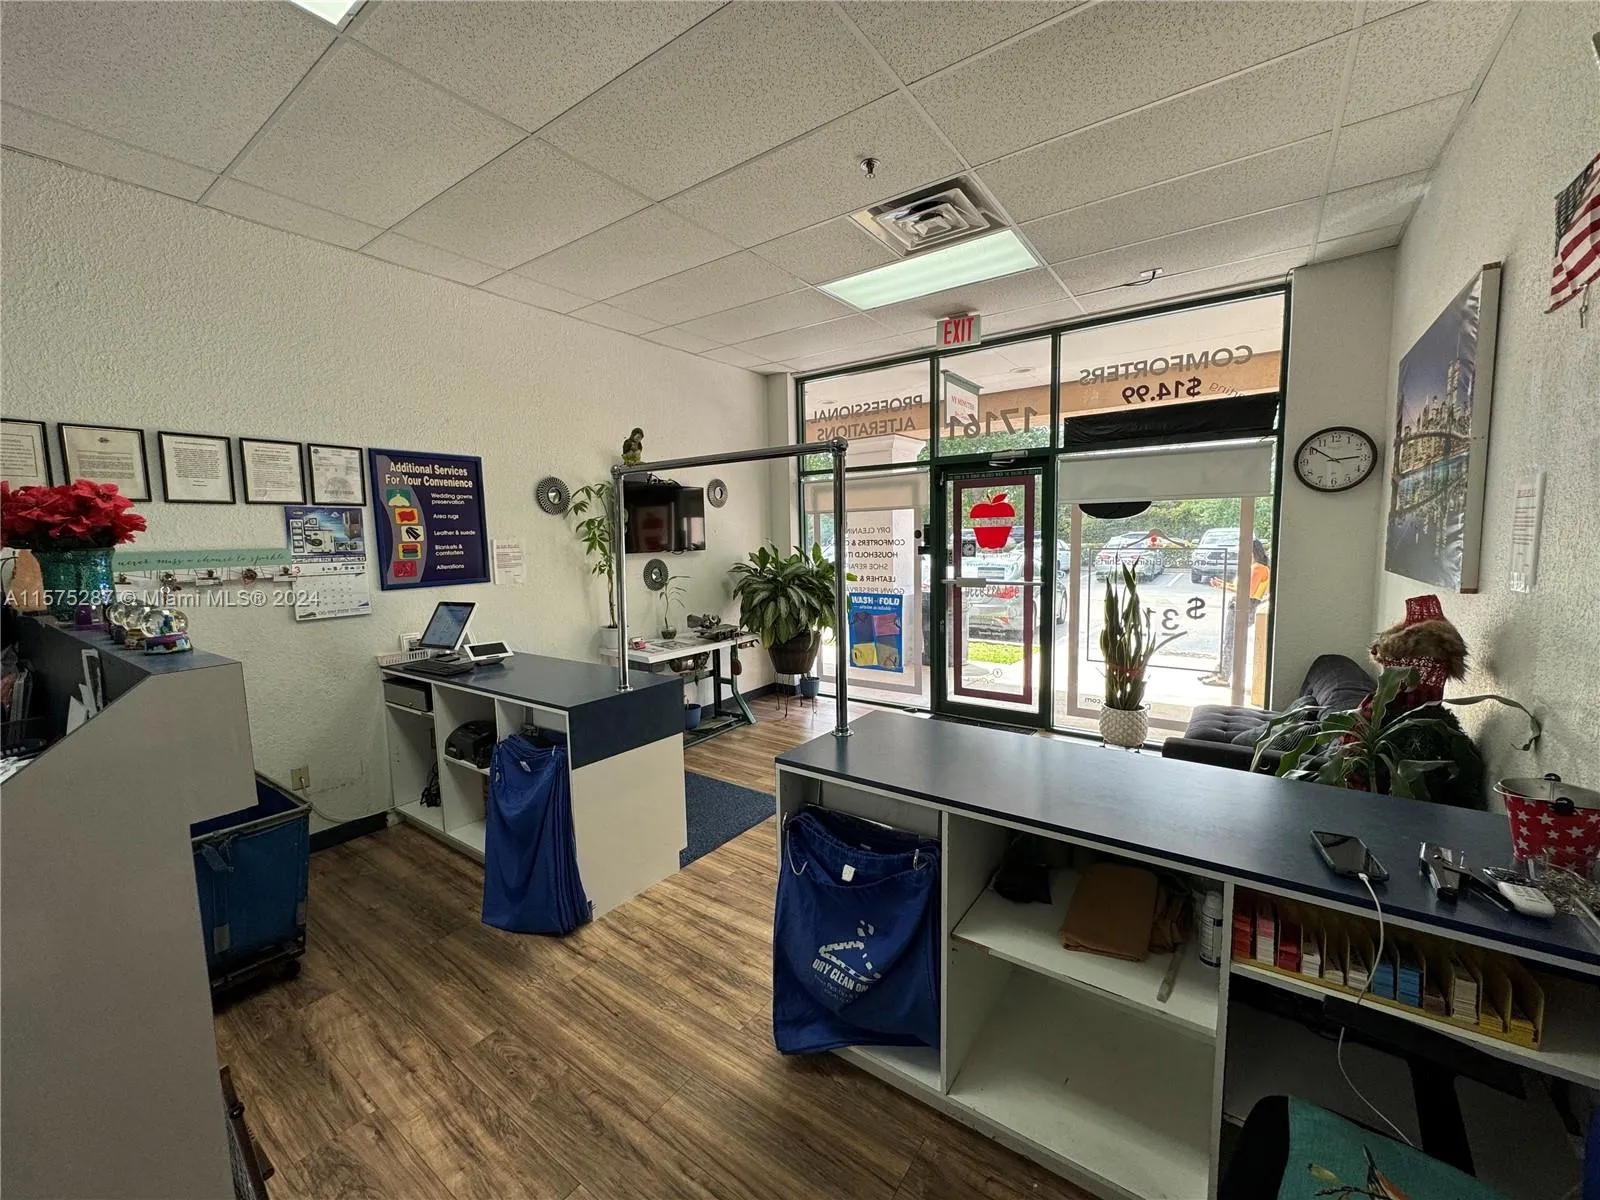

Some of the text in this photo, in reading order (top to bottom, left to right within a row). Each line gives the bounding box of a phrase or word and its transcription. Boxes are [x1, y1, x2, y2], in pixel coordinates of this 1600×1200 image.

[943, 315, 974, 345] EXIT
[389, 462, 468, 477] Additional Services
[385, 474, 473, 488] For Your Convenience
[430, 492, 456, 500] Wedding
[851, 595, 873, 605] WASH
[879, 597, 900, 606] FOLD
[811, 958, 832, 975] DRY
[829, 968, 855, 991] CLEAN
